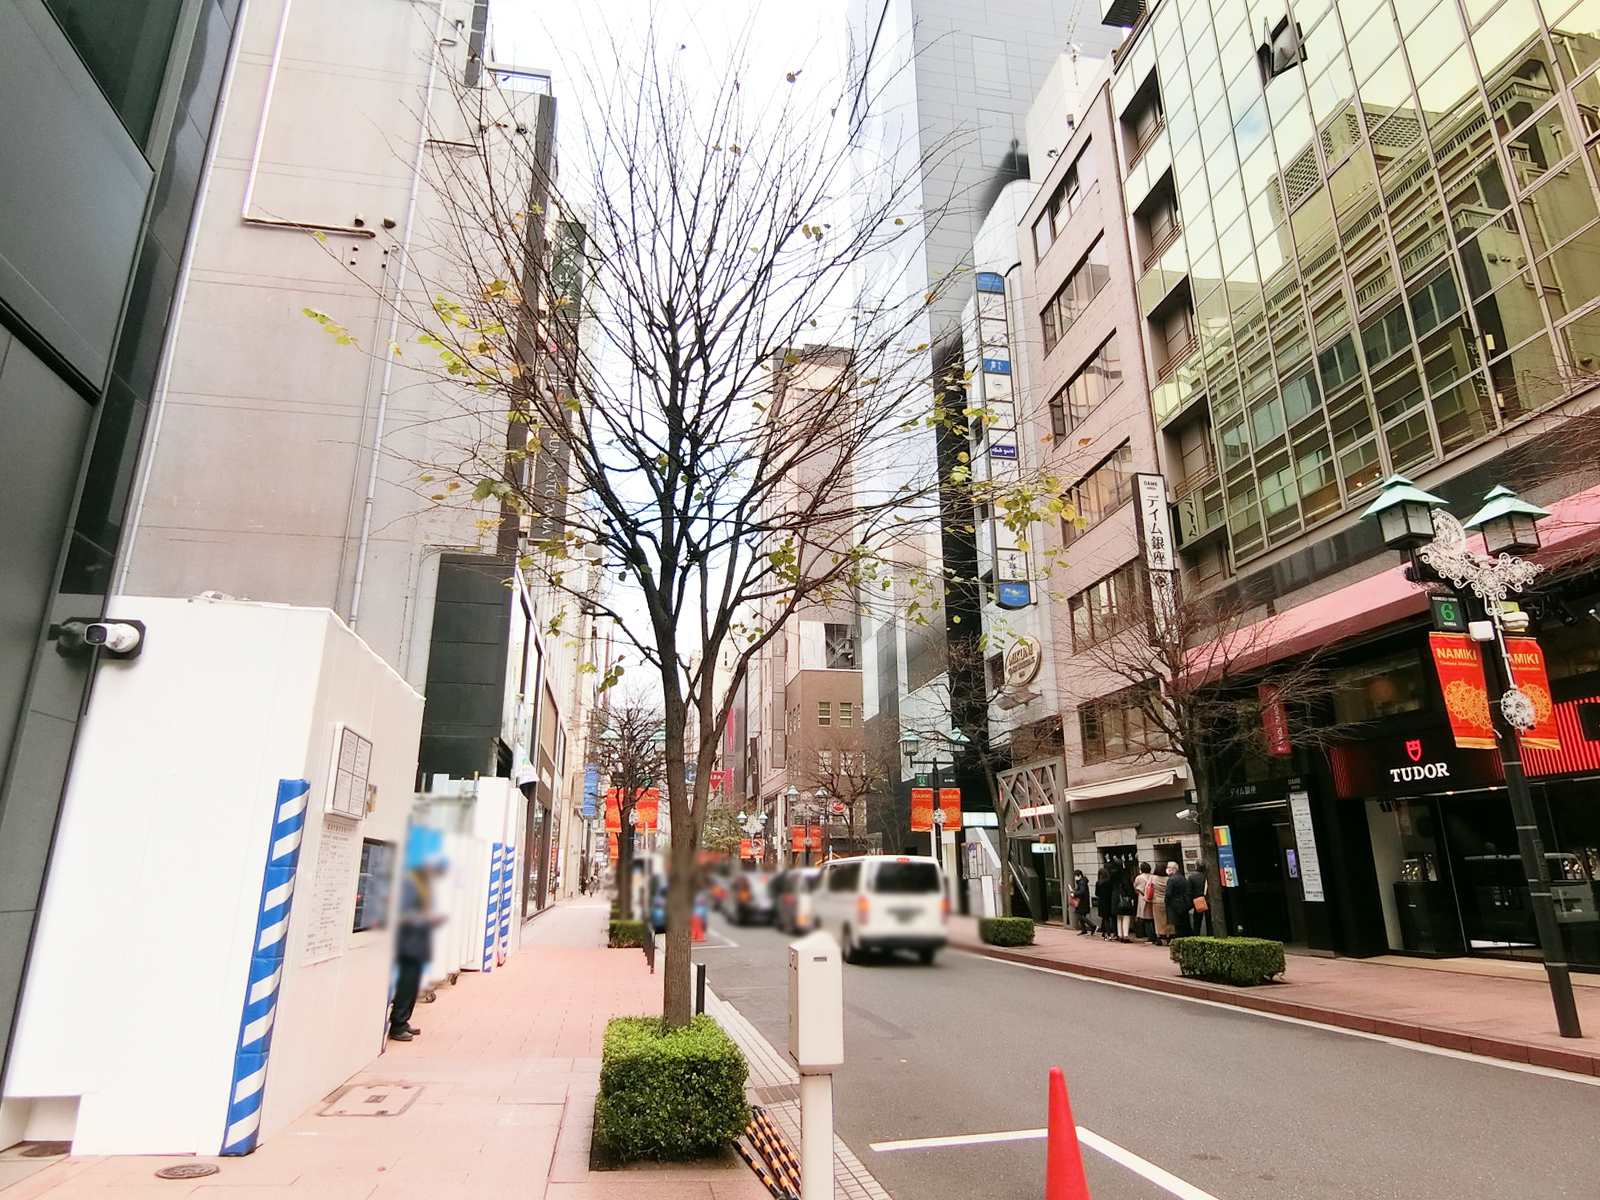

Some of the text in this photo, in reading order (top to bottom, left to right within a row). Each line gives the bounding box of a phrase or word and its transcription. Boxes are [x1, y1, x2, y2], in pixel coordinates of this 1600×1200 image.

[541, 461, 557, 534] MOTOAMA
[1441, 603, 1455, 621] 6
[1436, 647, 1477, 660] NAMIKI
[1507, 653, 1539, 664] AMIKI
[1390, 762, 1450, 782] TUDOR
